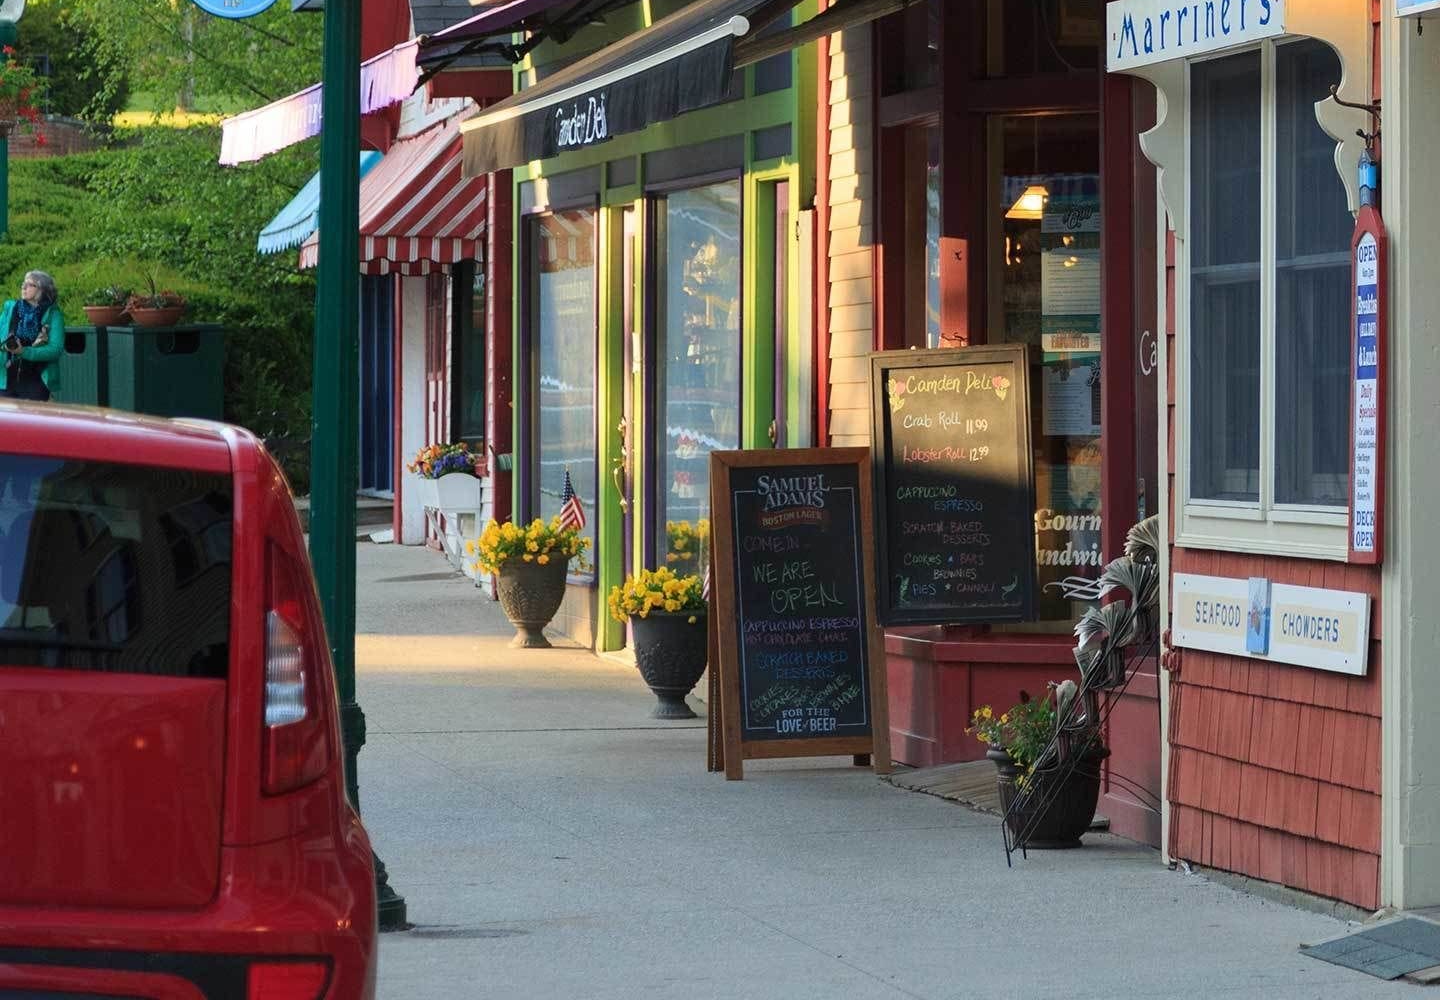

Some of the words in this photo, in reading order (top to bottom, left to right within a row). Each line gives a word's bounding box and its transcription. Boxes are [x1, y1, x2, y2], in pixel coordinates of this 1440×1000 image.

[584, 92, 608, 144] Deli
[757, 473, 830, 496] SAMUEL
[763, 489, 825, 512] ADAMS
[770, 580, 845, 614] OPEN
[1195, 600, 1241, 628] SEAFOOD
[1281, 612, 1340, 643] CHOWDERS
[776, 718, 803, 734] LOVE
[810, 716, 837, 732] BEER
